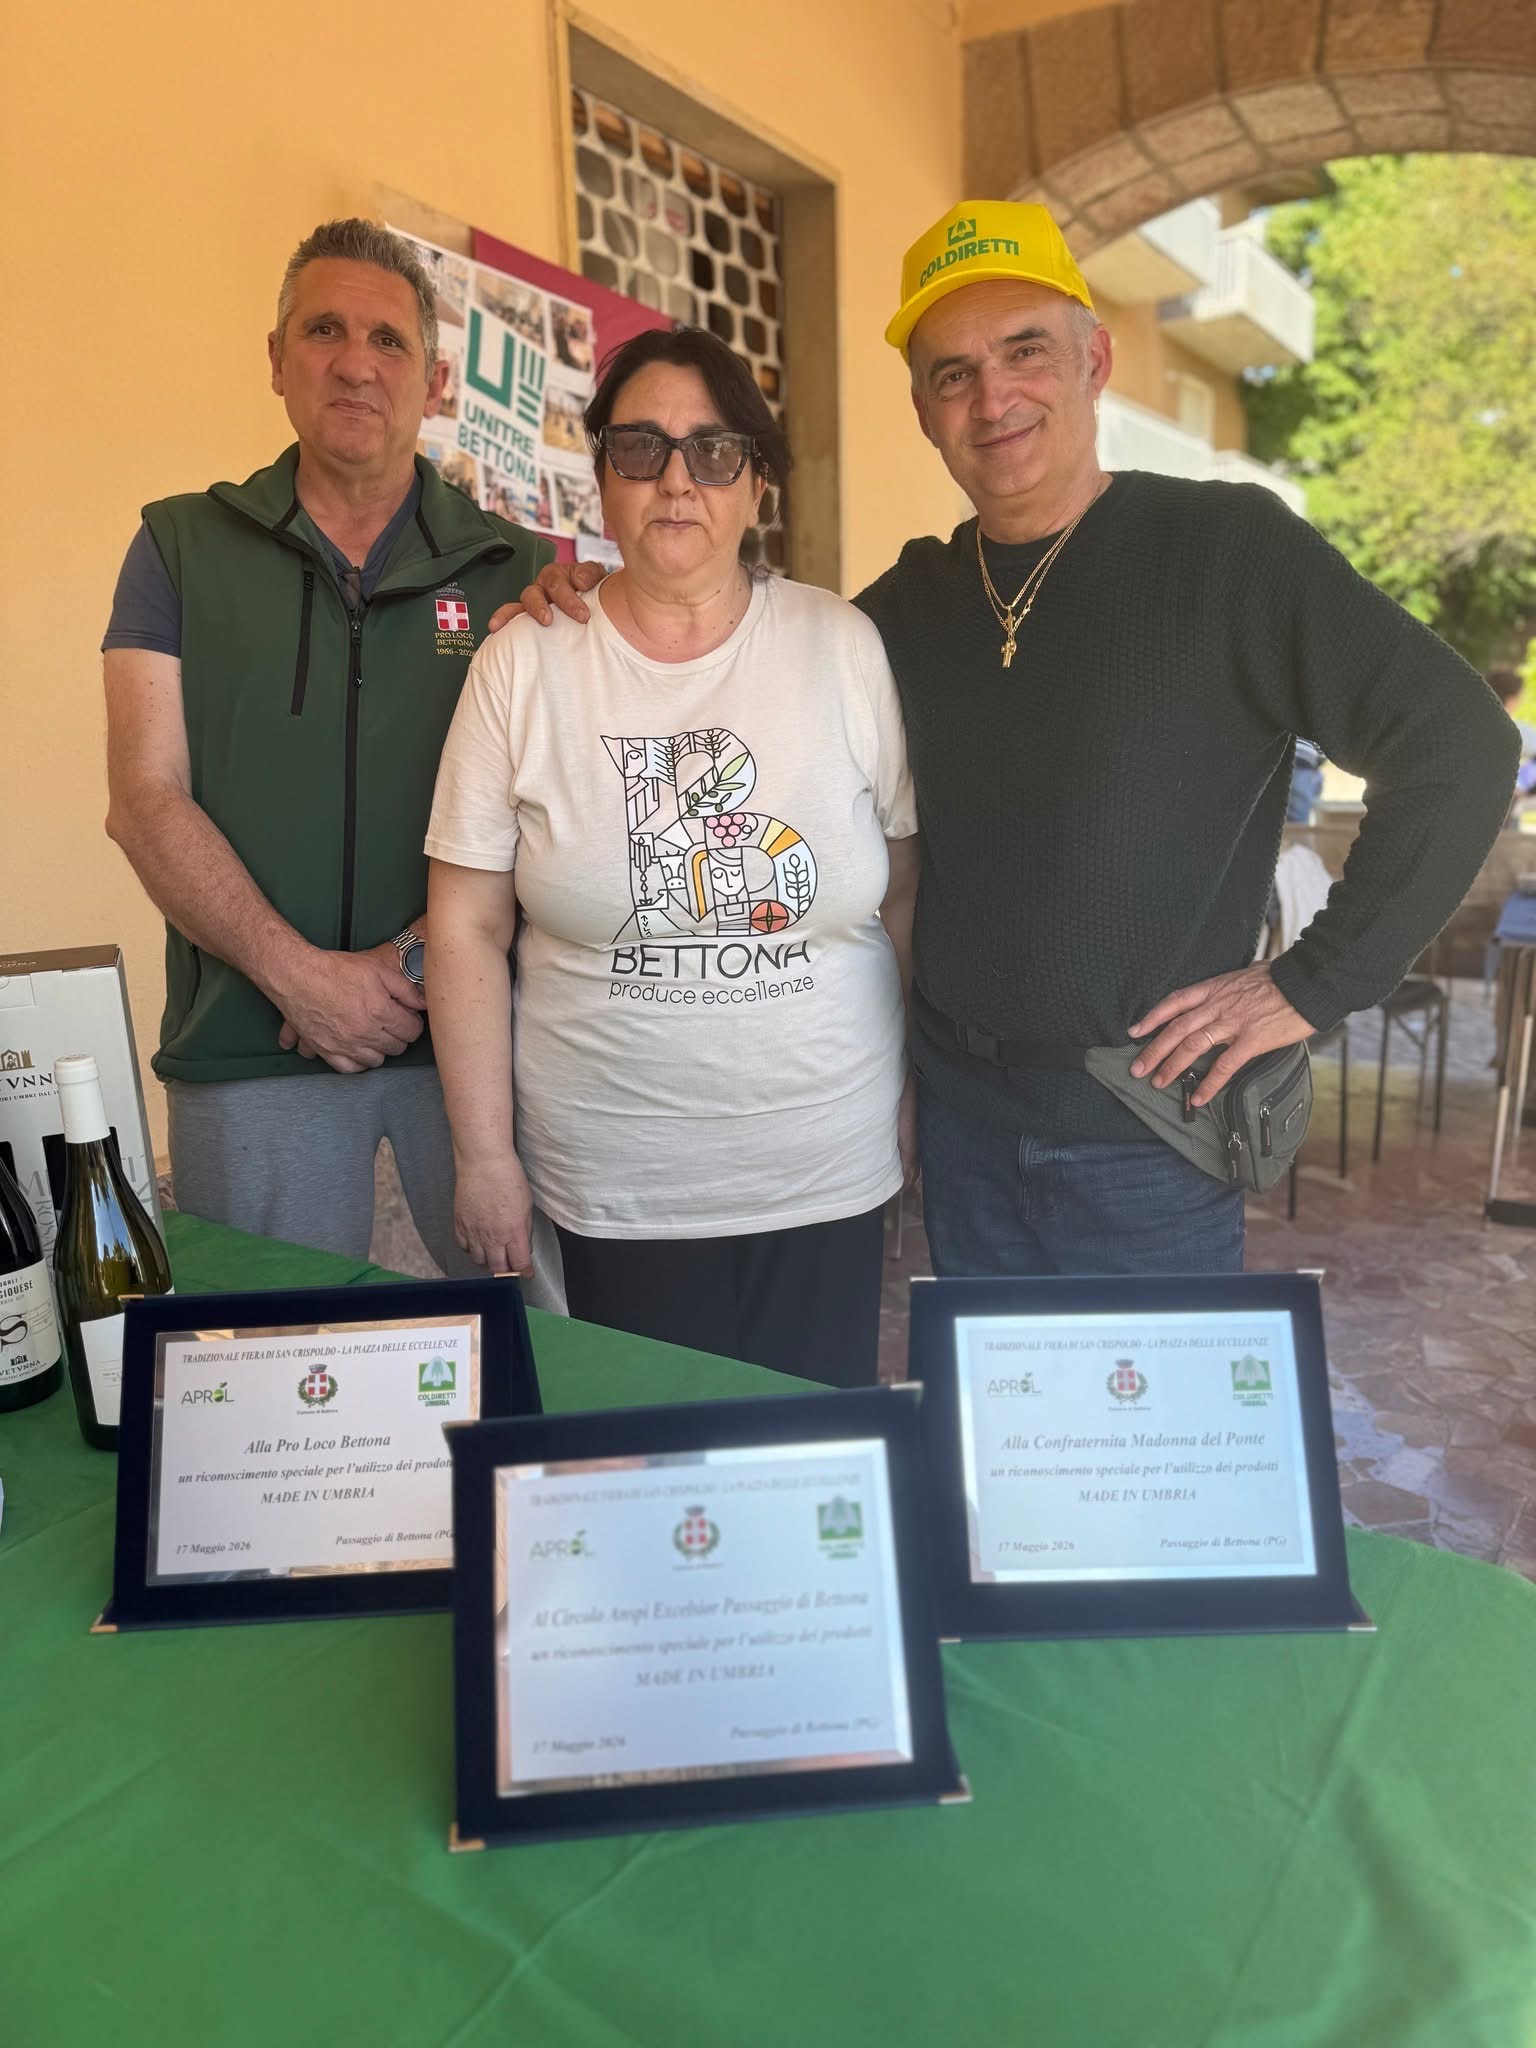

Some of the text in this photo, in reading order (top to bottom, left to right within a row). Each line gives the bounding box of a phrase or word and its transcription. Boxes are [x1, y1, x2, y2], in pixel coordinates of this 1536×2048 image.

[920, 239, 1019, 287] COLDIRETTI
[465, 400, 535, 459] UNITRE
[458, 424, 538, 489] BETTONA
[437, 639, 474, 647] BETTONA
[452, 632, 474, 640] LOCO
[611, 939, 811, 979] BETTONA
[609, 976, 814, 1005] produce eccellenze
[183, 1352, 240, 1363] TRADIZIONALE
[241, 1350, 265, 1360] FIERA
[265, 1349, 275, 1359] DI
[275, 1349, 293, 1359] SAN
[293, 1346, 336, 1357] CRISPOLDO
[342, 1346, 353, 1355] LA
[352, 1344, 381, 1354] PIAZZA
[381, 1342, 407, 1352] DELLE
[408, 1339, 459, 1351] ECCELLENZE
[987, 1375, 1042, 1394] APROL
[181, 1385, 234, 1404] APROL
[418, 1393, 456, 1401] COLDIRETTI
[244, 1435, 391, 1454] Alla Pro Loco Bettona
[1001, 1431, 1265, 1453] Alla Confraternita Madonna del Ponte
[178, 1474, 192, 1484] un
[196, 1469, 278, 1483] riconoscimento
[281, 1465, 323, 1481] speciale
[326, 1467, 344, 1478] per
[396, 1459, 412, 1471] dei
[990, 1468, 1005, 1477] un
[1008, 1464, 1093, 1477] riconoscimento
[1096, 1463, 1140, 1478] speciale
[1143, 1465, 1161, 1477] per
[1216, 1460, 1232, 1473] dei
[1235, 1459, 1279, 1476] prodotti
[260, 1487, 375, 1504] MADE IN UMBRIA
[1079, 1488, 1197, 1502] MADE IN UMBRIA
[336, 1529, 455, 1546] Passaggio di Bettona (PG
[998, 1541, 1010, 1552] 17
[1051, 1541, 1074, 1551] 2026
[1263, 1535, 1287, 1546] (PG)
[176, 1541, 251, 1554] 17 Maggio 2026
